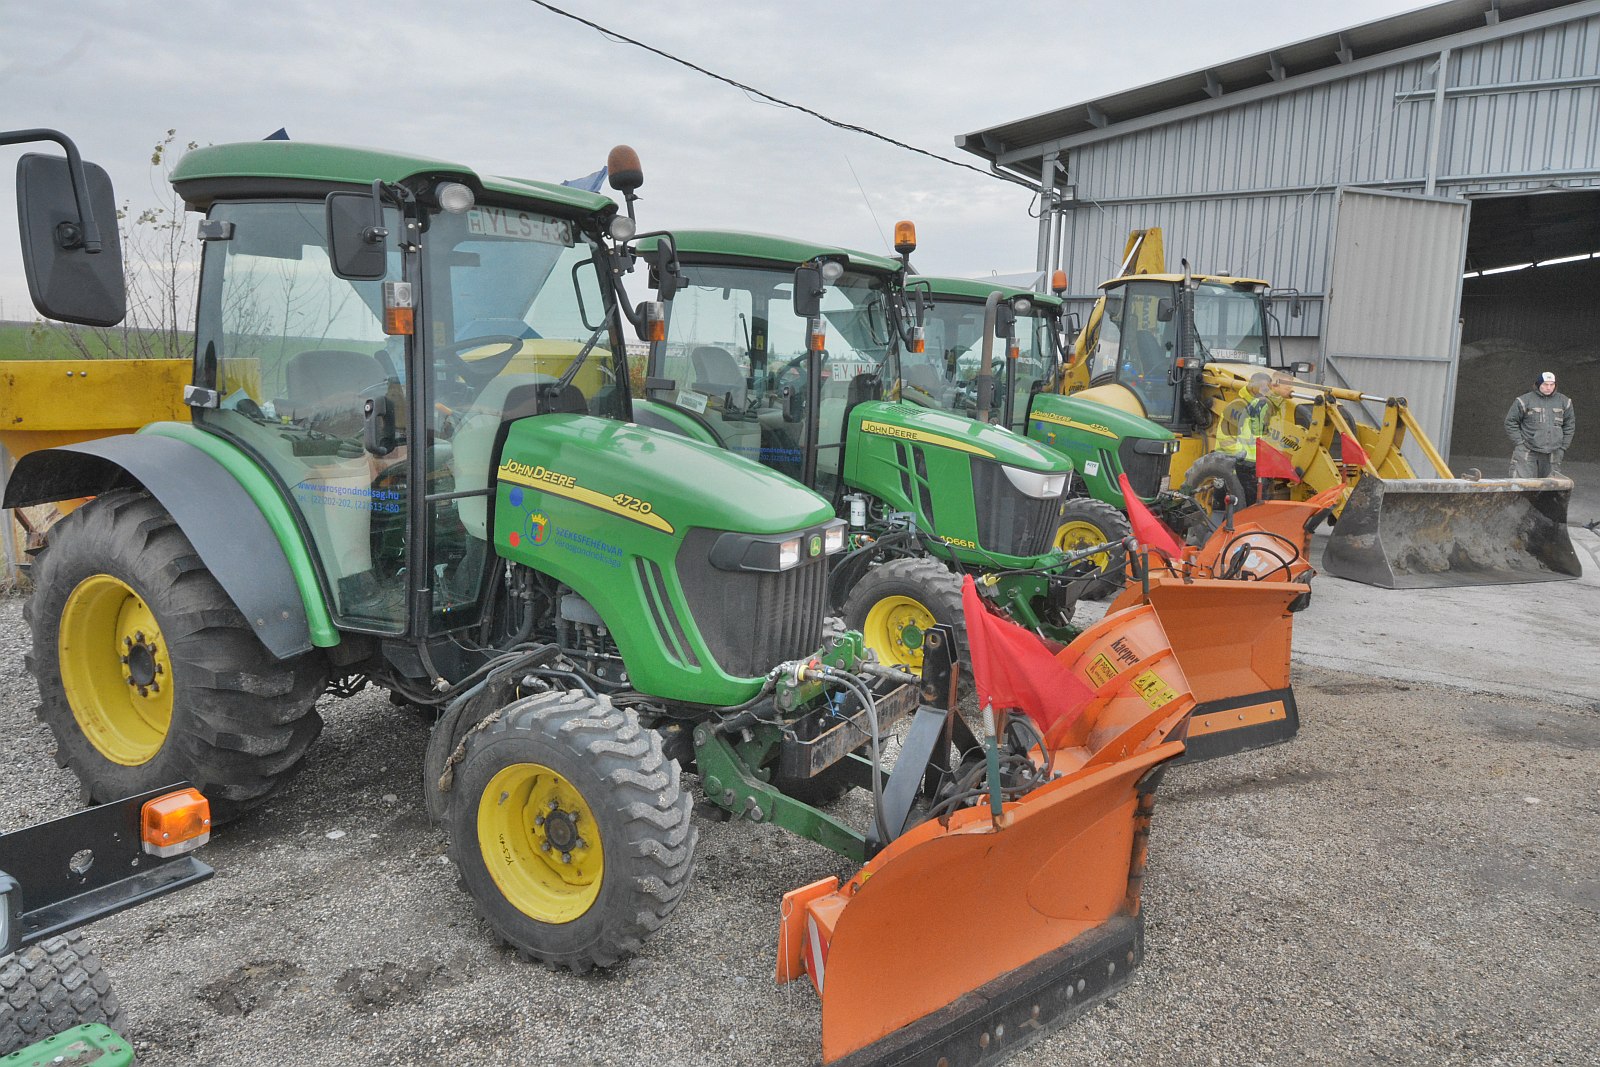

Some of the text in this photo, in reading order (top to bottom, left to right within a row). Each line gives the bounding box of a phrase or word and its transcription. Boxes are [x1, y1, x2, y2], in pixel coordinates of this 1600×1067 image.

[865, 423, 918, 440] JOHN DEERE
[501, 458, 577, 489] JOHN DEERE
[612, 493, 652, 514] 4720
